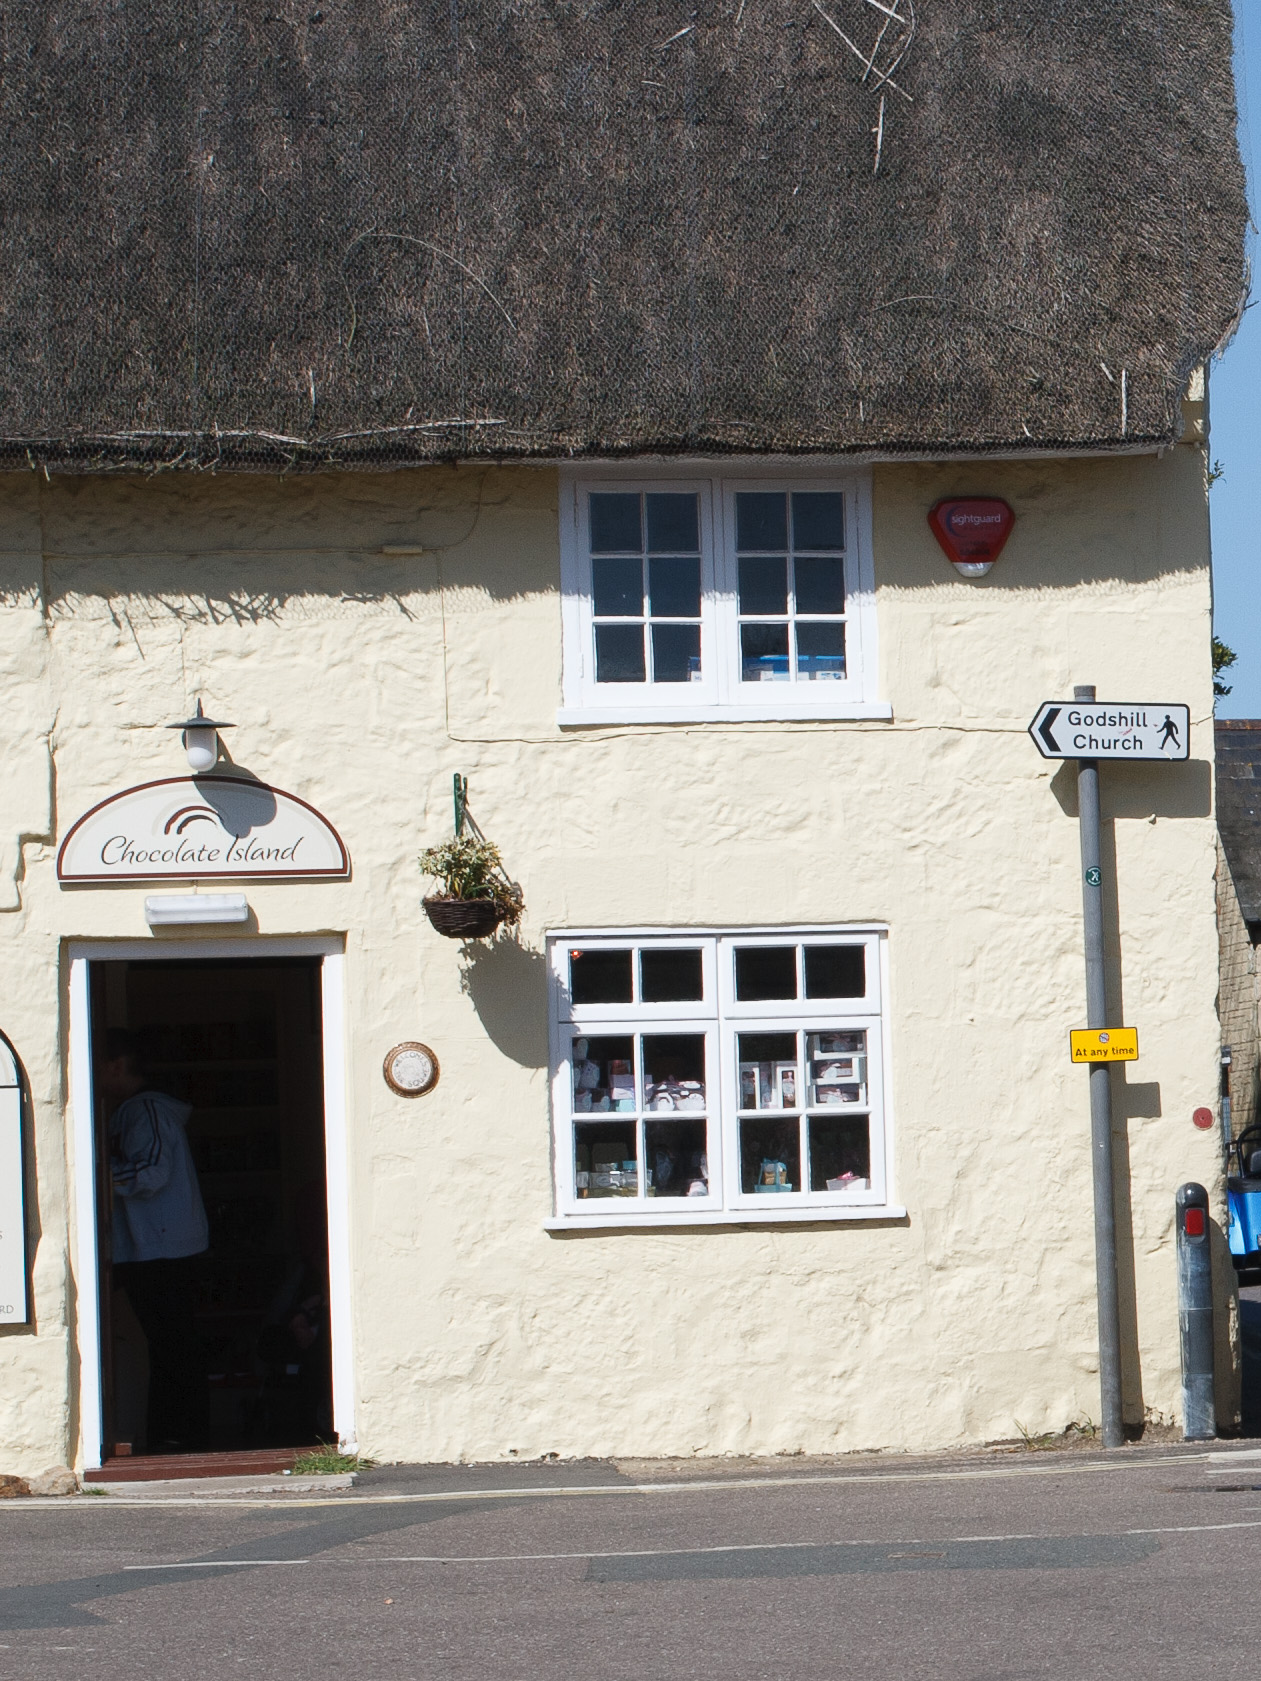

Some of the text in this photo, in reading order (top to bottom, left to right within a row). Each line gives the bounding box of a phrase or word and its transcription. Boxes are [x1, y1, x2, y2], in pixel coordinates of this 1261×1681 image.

[952, 514, 1001, 525] sightguard
[1068, 711, 1148, 727] Godshill
[1073, 734, 1143, 750] Church
[101, 834, 304, 865] Chocolate Island
[1075, 1046, 1135, 1057] At any time
